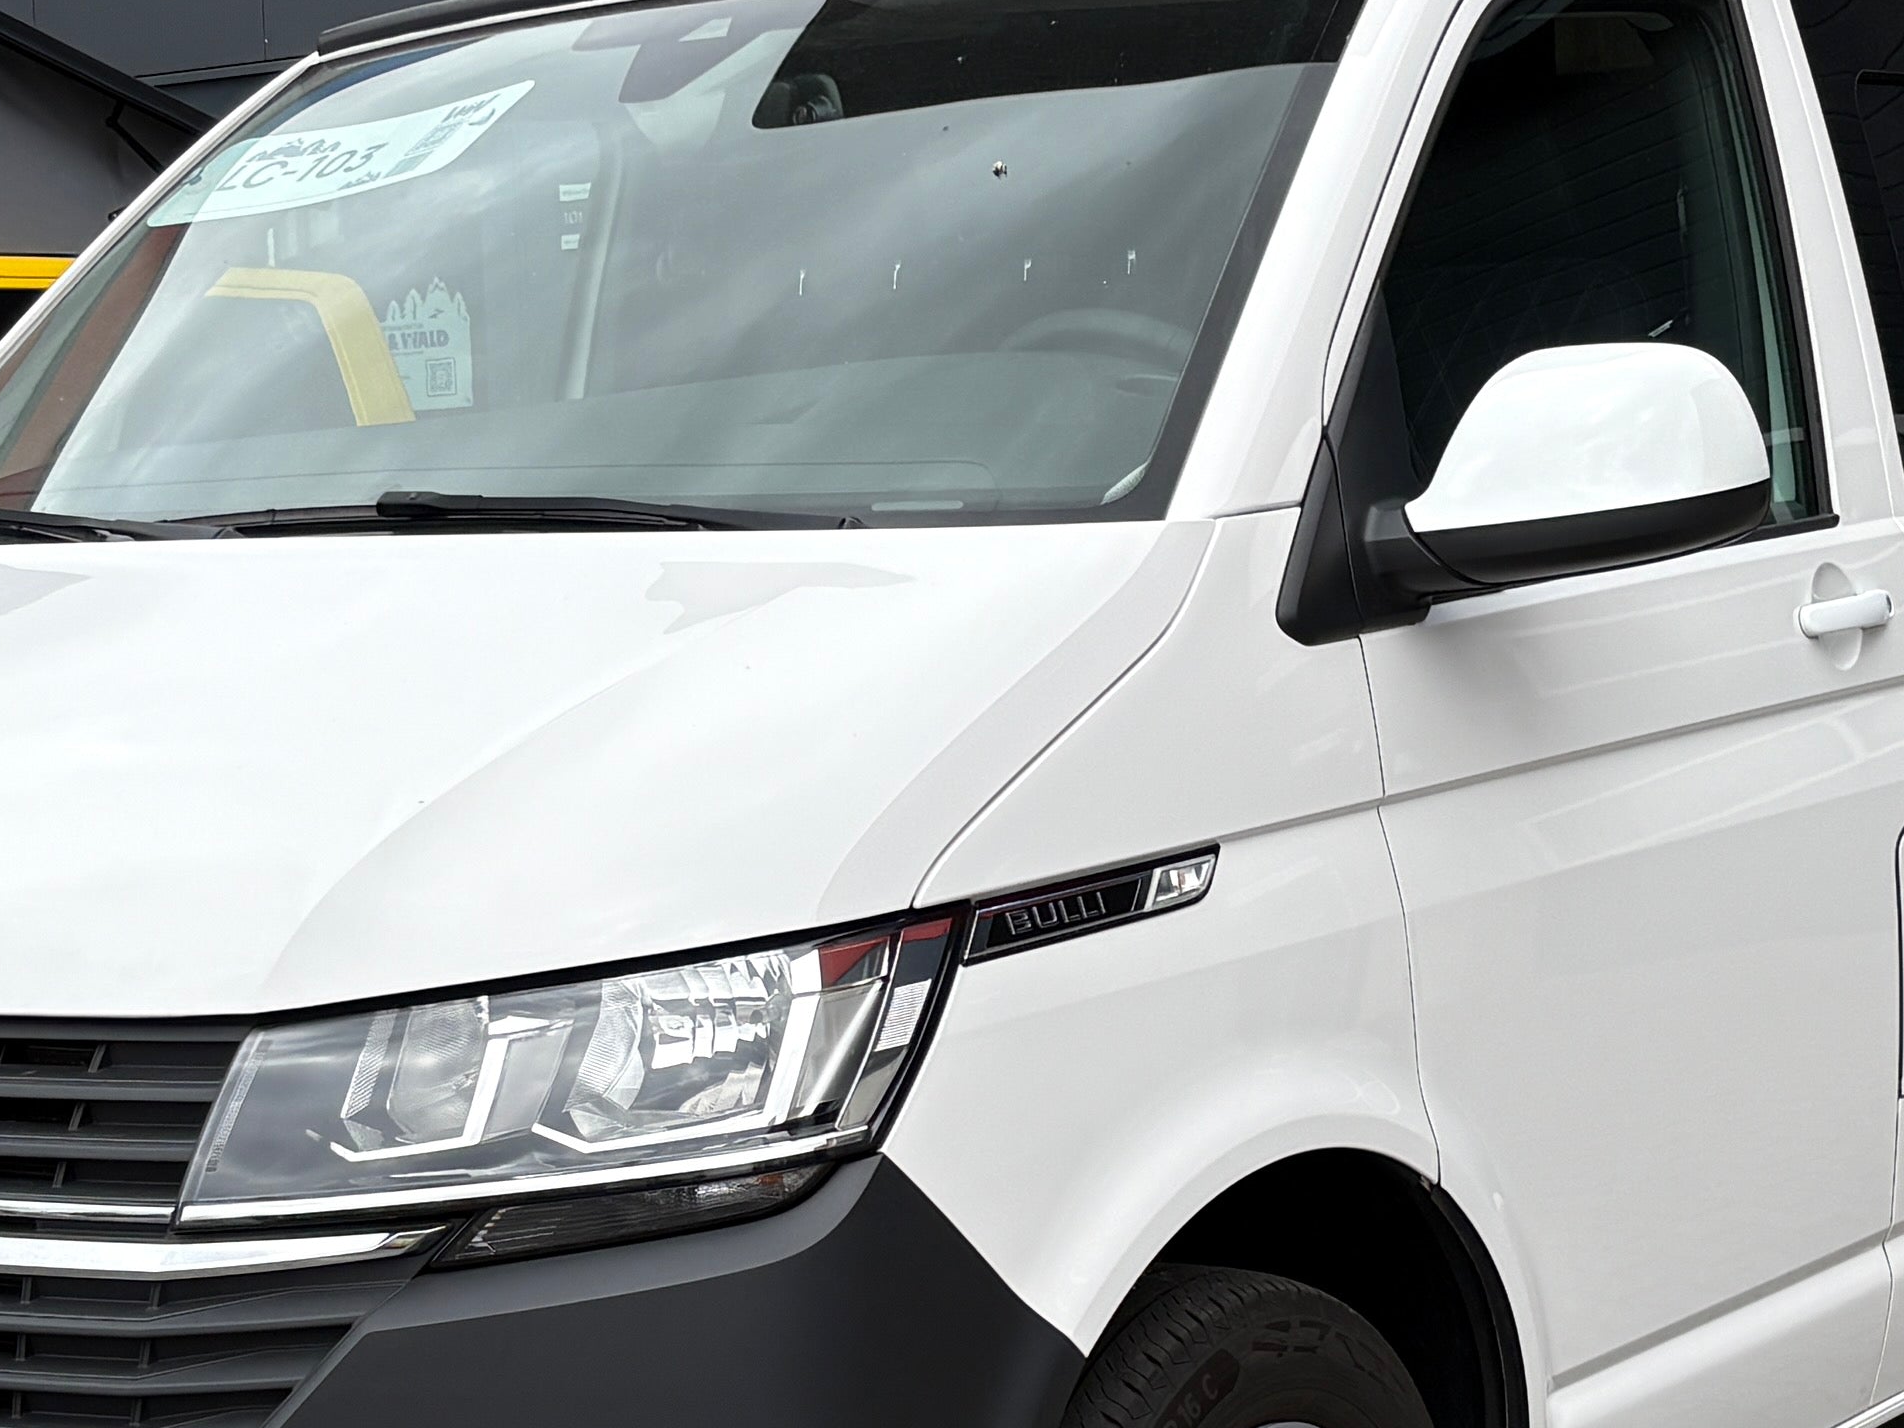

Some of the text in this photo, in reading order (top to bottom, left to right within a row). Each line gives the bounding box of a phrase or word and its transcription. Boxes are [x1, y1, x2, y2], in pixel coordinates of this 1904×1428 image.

[215, 141, 389, 192] LC-103
[1004, 891, 1107, 935] BULLI
[1177, 1398, 1203, 1425] 16
[1201, 1373, 1219, 1402] C
